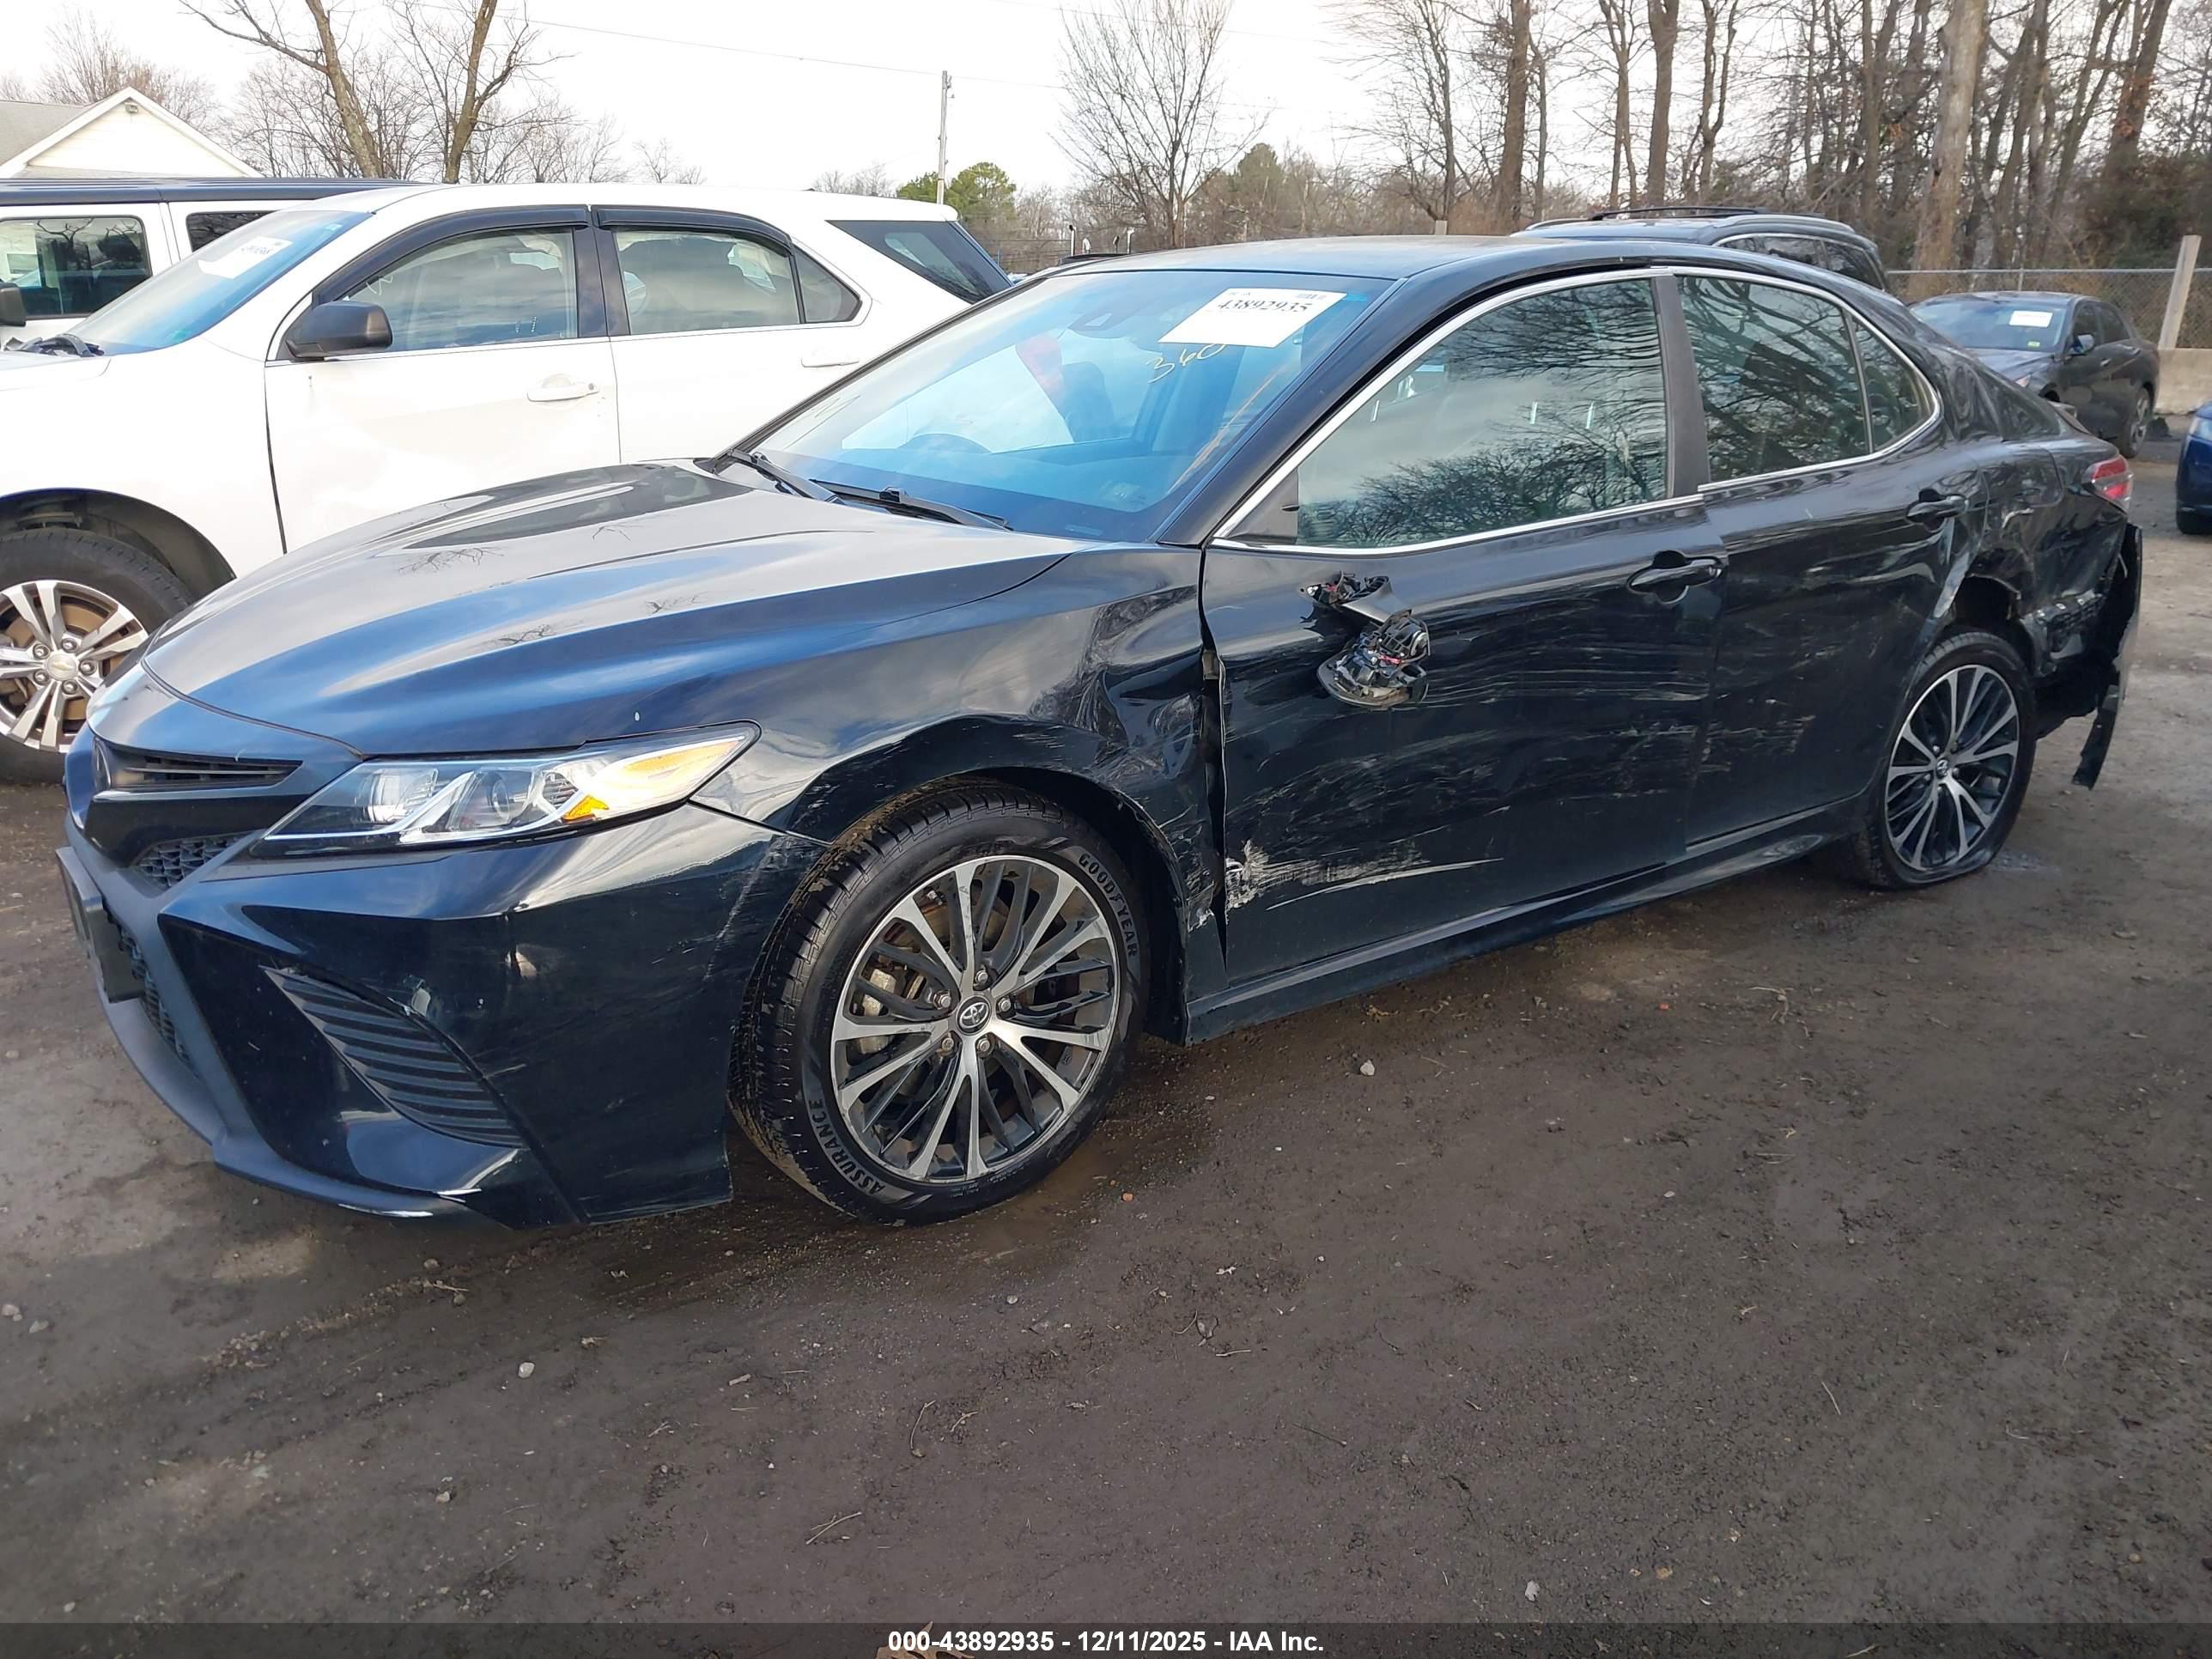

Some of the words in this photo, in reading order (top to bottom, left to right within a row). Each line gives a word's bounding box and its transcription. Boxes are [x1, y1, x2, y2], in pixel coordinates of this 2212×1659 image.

[1216, 299, 1314, 313] 43892935
[1145, 343, 1227, 385] 360
[1078, 853, 1139, 957] GOODYEAR
[808, 1099, 886, 1195] ASSURANCE
